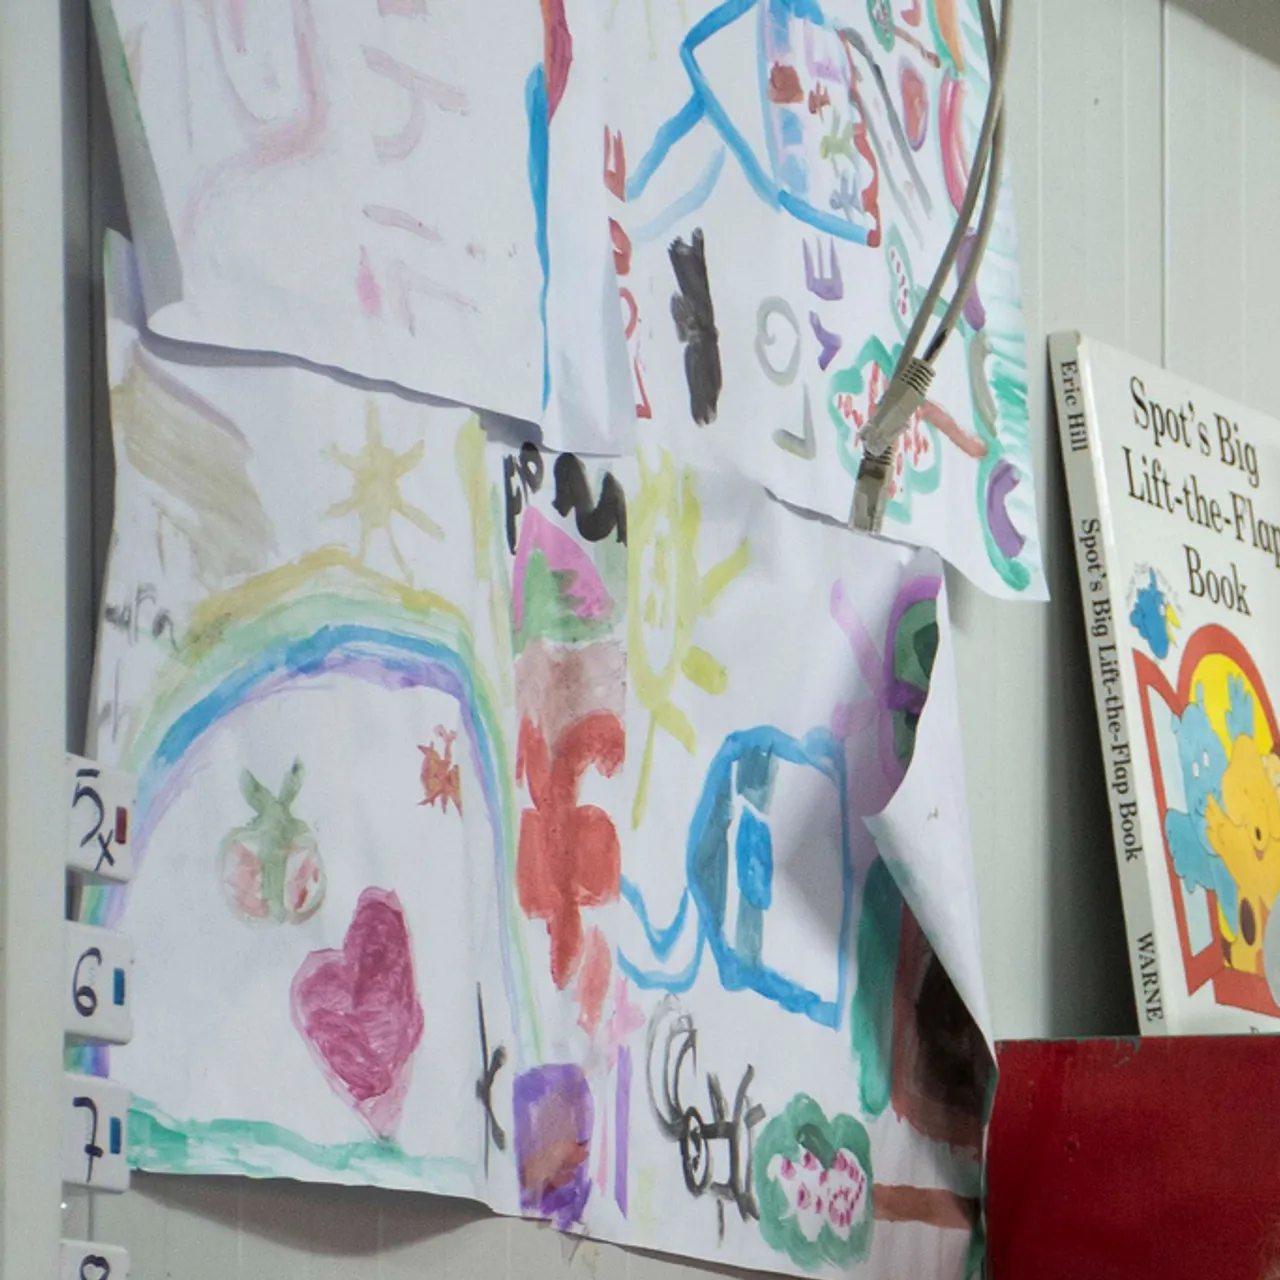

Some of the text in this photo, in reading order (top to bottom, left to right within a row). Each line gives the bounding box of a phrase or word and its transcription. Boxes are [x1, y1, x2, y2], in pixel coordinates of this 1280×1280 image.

[1060, 359, 1090, 453] Eric Hill
[1129, 375, 1261, 489] Spot's Big
[1182, 543, 1253, 618] Book
[1080, 518, 1143, 863] Spot's Big Lift-the-Flap Book
[72, 947, 103, 1018] 6
[1136, 931, 1164, 1023] WARNE
[72, 1096, 103, 1184] 7
